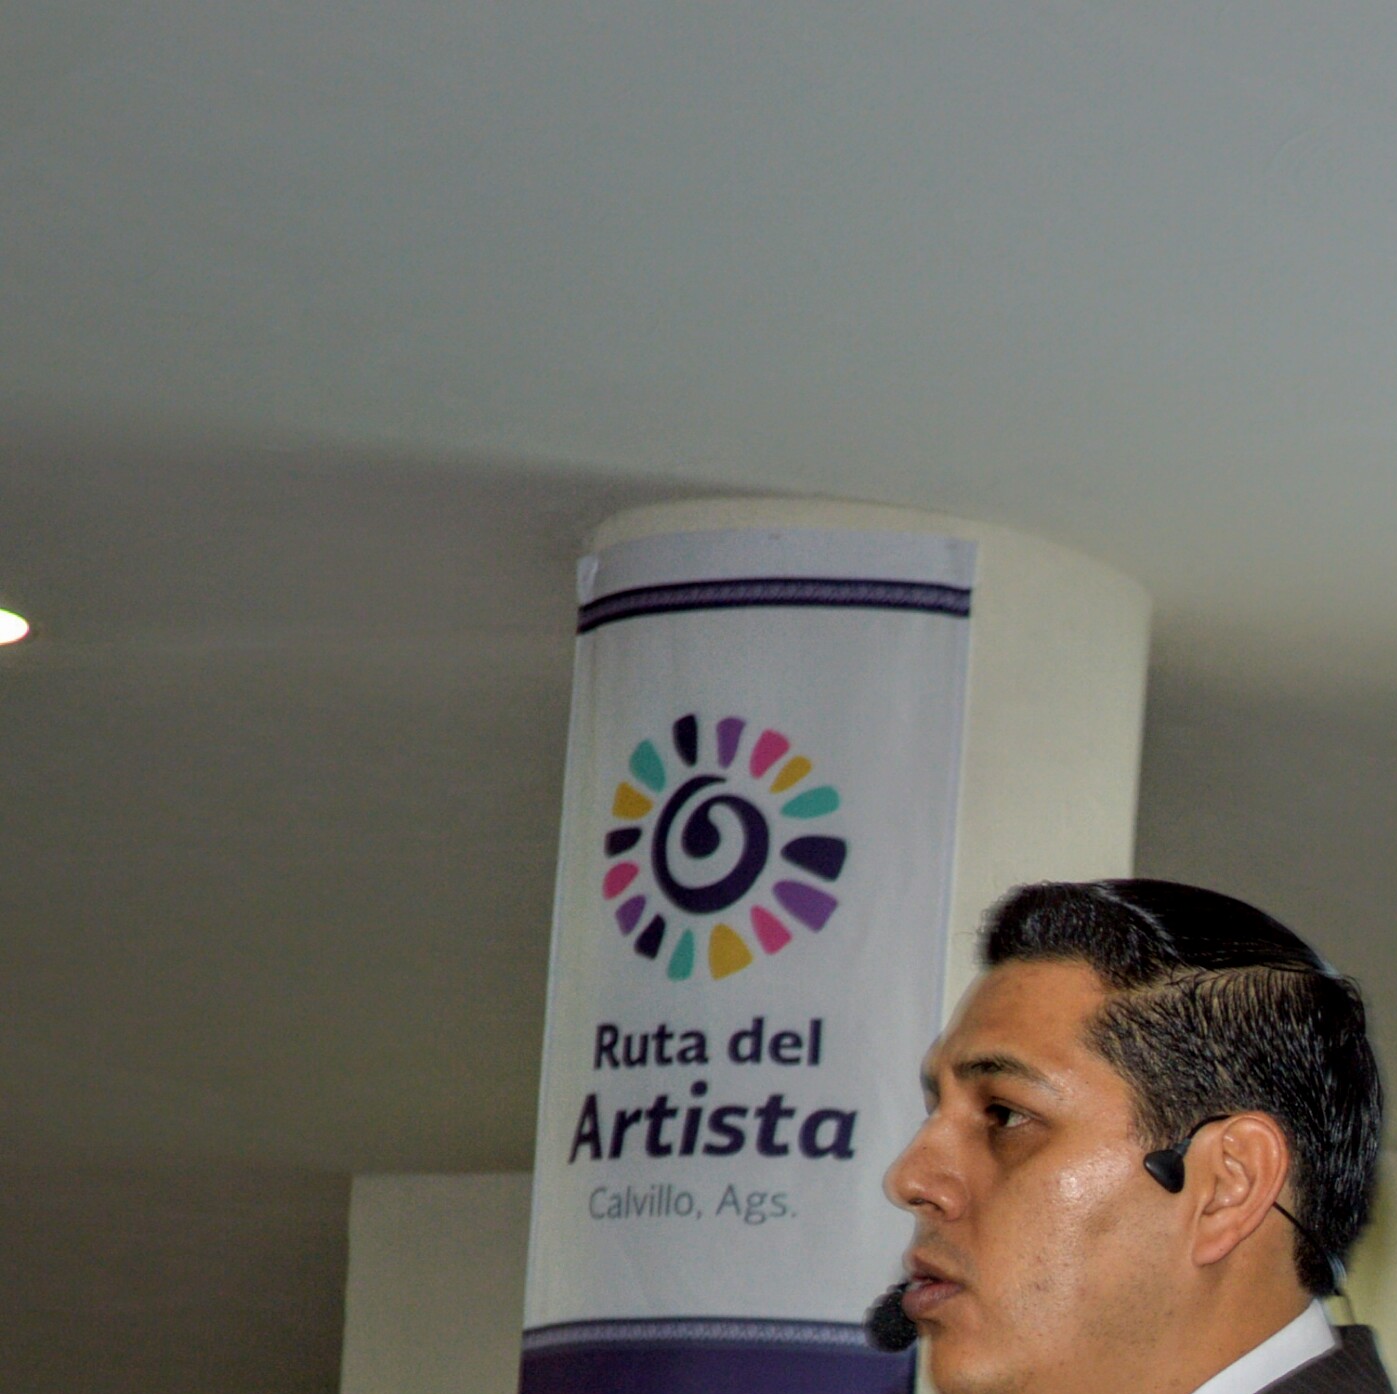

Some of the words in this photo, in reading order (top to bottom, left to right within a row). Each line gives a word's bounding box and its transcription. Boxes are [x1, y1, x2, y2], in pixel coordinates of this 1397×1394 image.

[594, 1023, 709, 1070] Ruta
[728, 1017, 823, 1066] del
[569, 1081, 858, 1163] Artista
[588, 1184, 702, 1221] Calvillo,
[715, 1184, 798, 1225] Ags.
